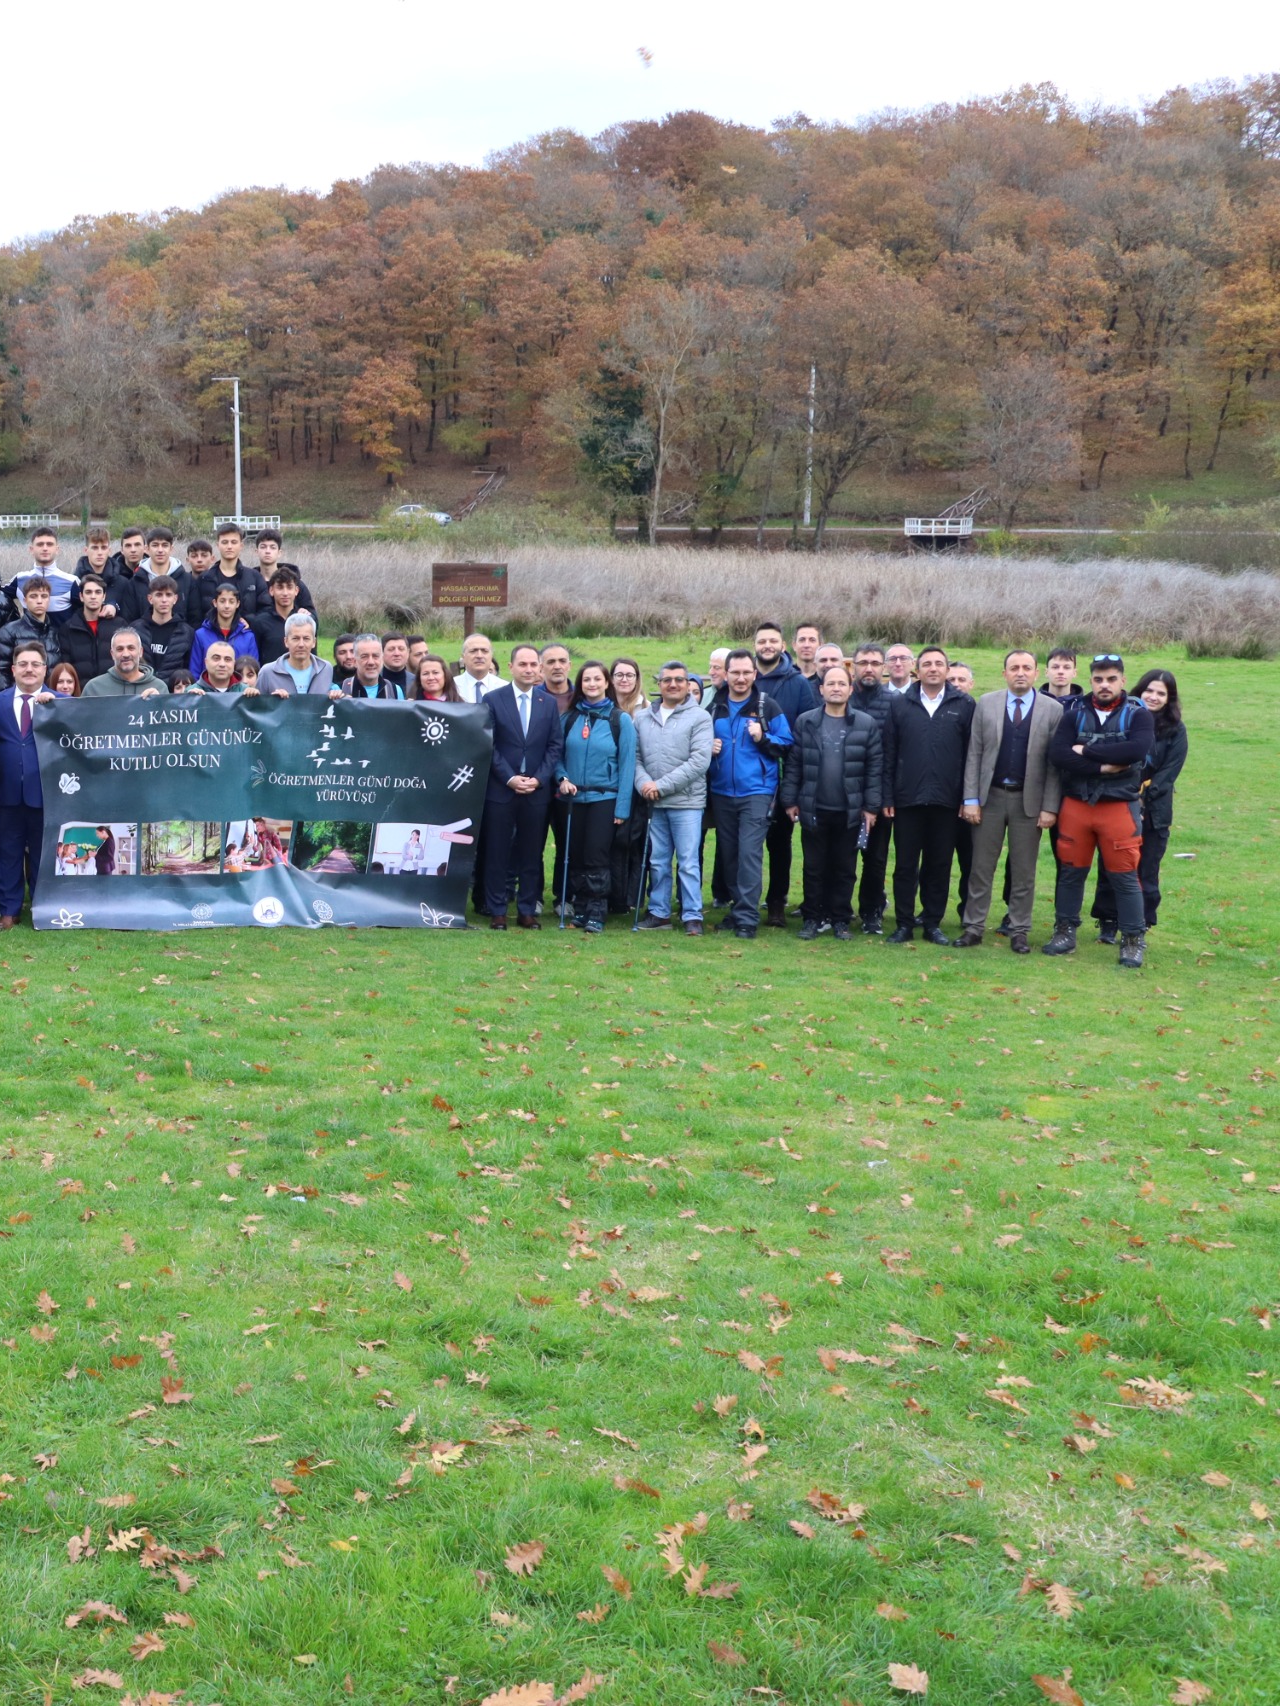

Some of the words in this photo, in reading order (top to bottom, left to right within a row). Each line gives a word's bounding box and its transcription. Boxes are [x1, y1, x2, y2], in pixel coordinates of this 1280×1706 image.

[128, 714, 144, 727] 24
[149, 709, 198, 725] KASIM
[59, 732, 182, 750] ÖĞRETMENLER
[186, 727, 263, 746] GÜNÜNÜZ
[109, 754, 162, 771] KUTLU
[166, 753, 221, 768] OLSUN
[268, 772, 354, 786] ÖĞRETMENLER
[357, 775, 391, 788] GÜNÜ
[393, 776, 427, 789] DOĞA
[316, 788, 377, 804] YÜRÜYÜŞÜ
